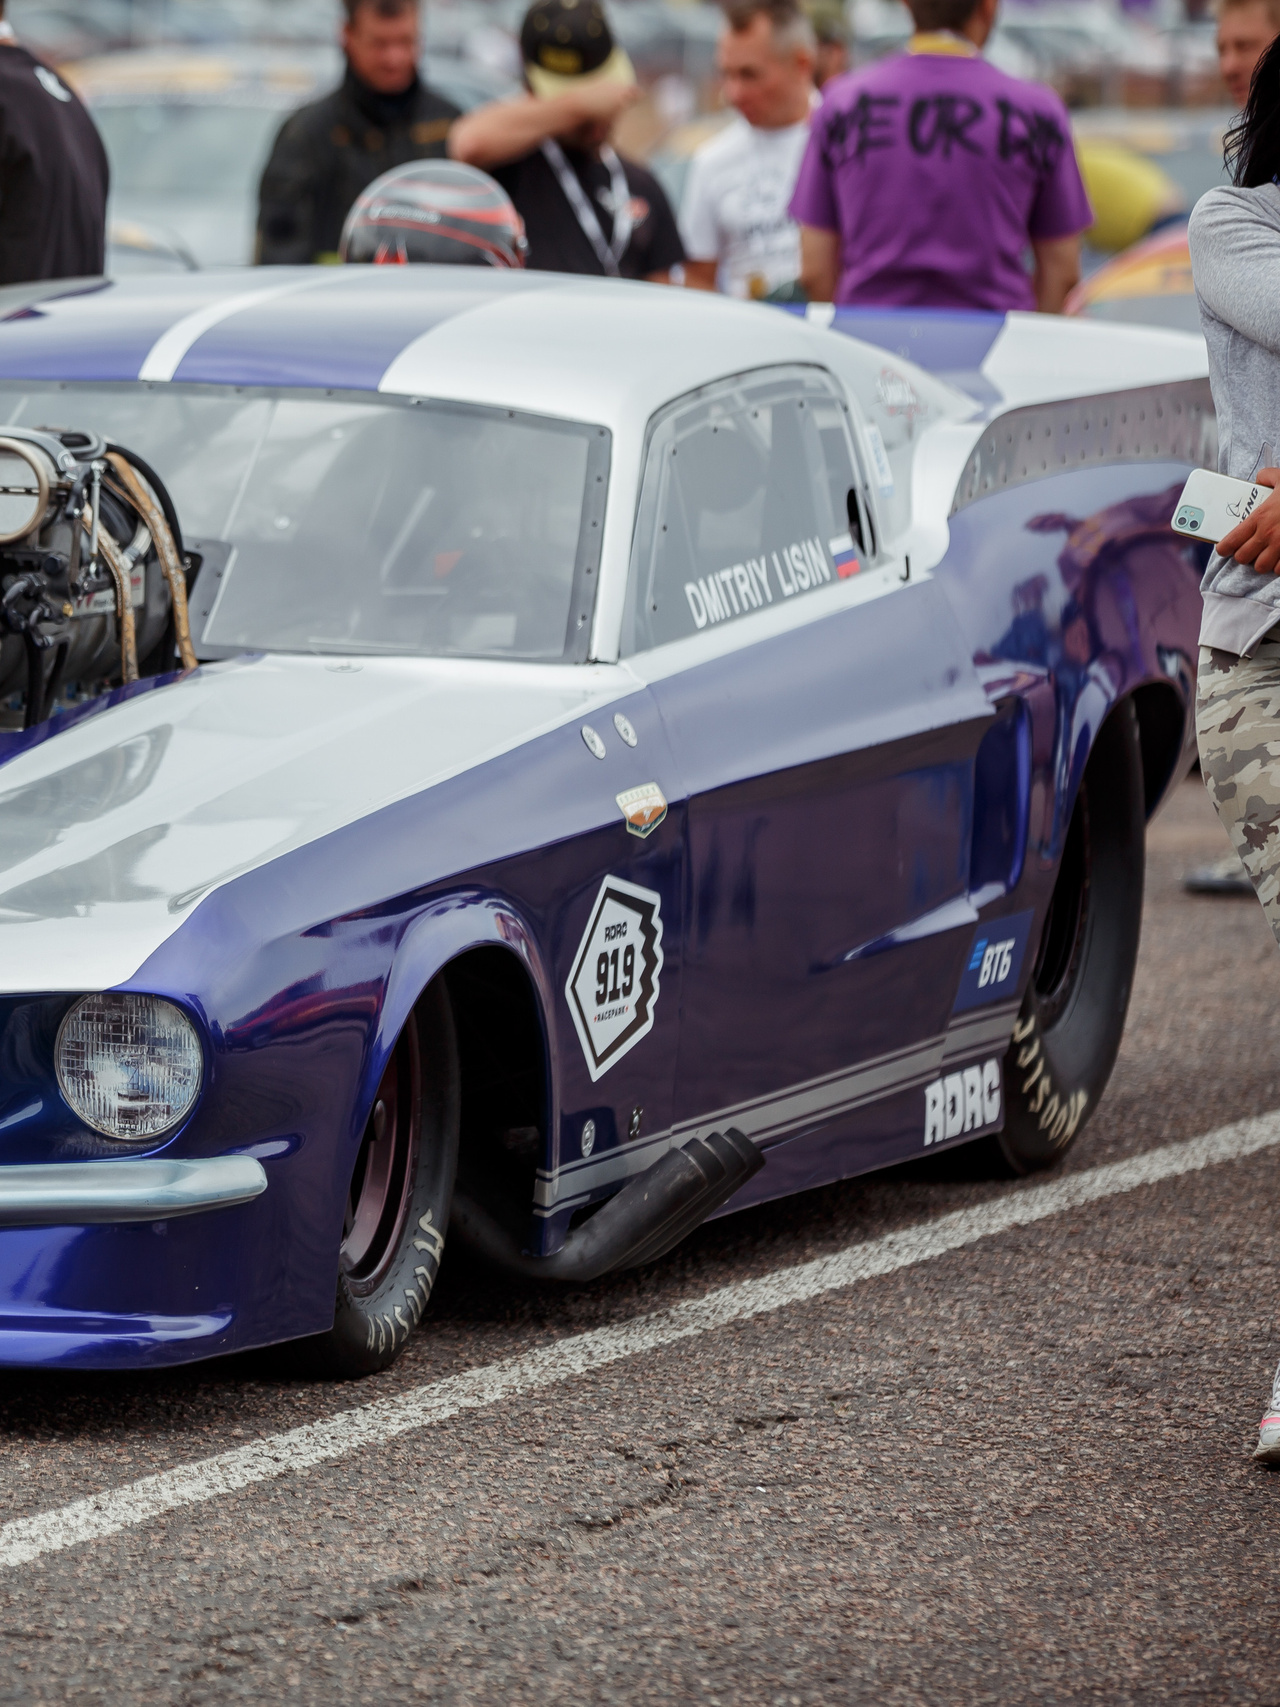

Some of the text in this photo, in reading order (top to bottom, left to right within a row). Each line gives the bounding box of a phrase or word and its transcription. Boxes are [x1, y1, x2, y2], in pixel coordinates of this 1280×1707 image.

[684, 535, 832, 630] DMITRIY LISIN
[604, 921, 628, 943] RDRC
[595, 943, 635, 1007] 919
[977, 937, 1017, 989] ВТБ
[597, 1004, 626, 1022] RACEPARK
[923, 1056, 1002, 1147] RDRC
